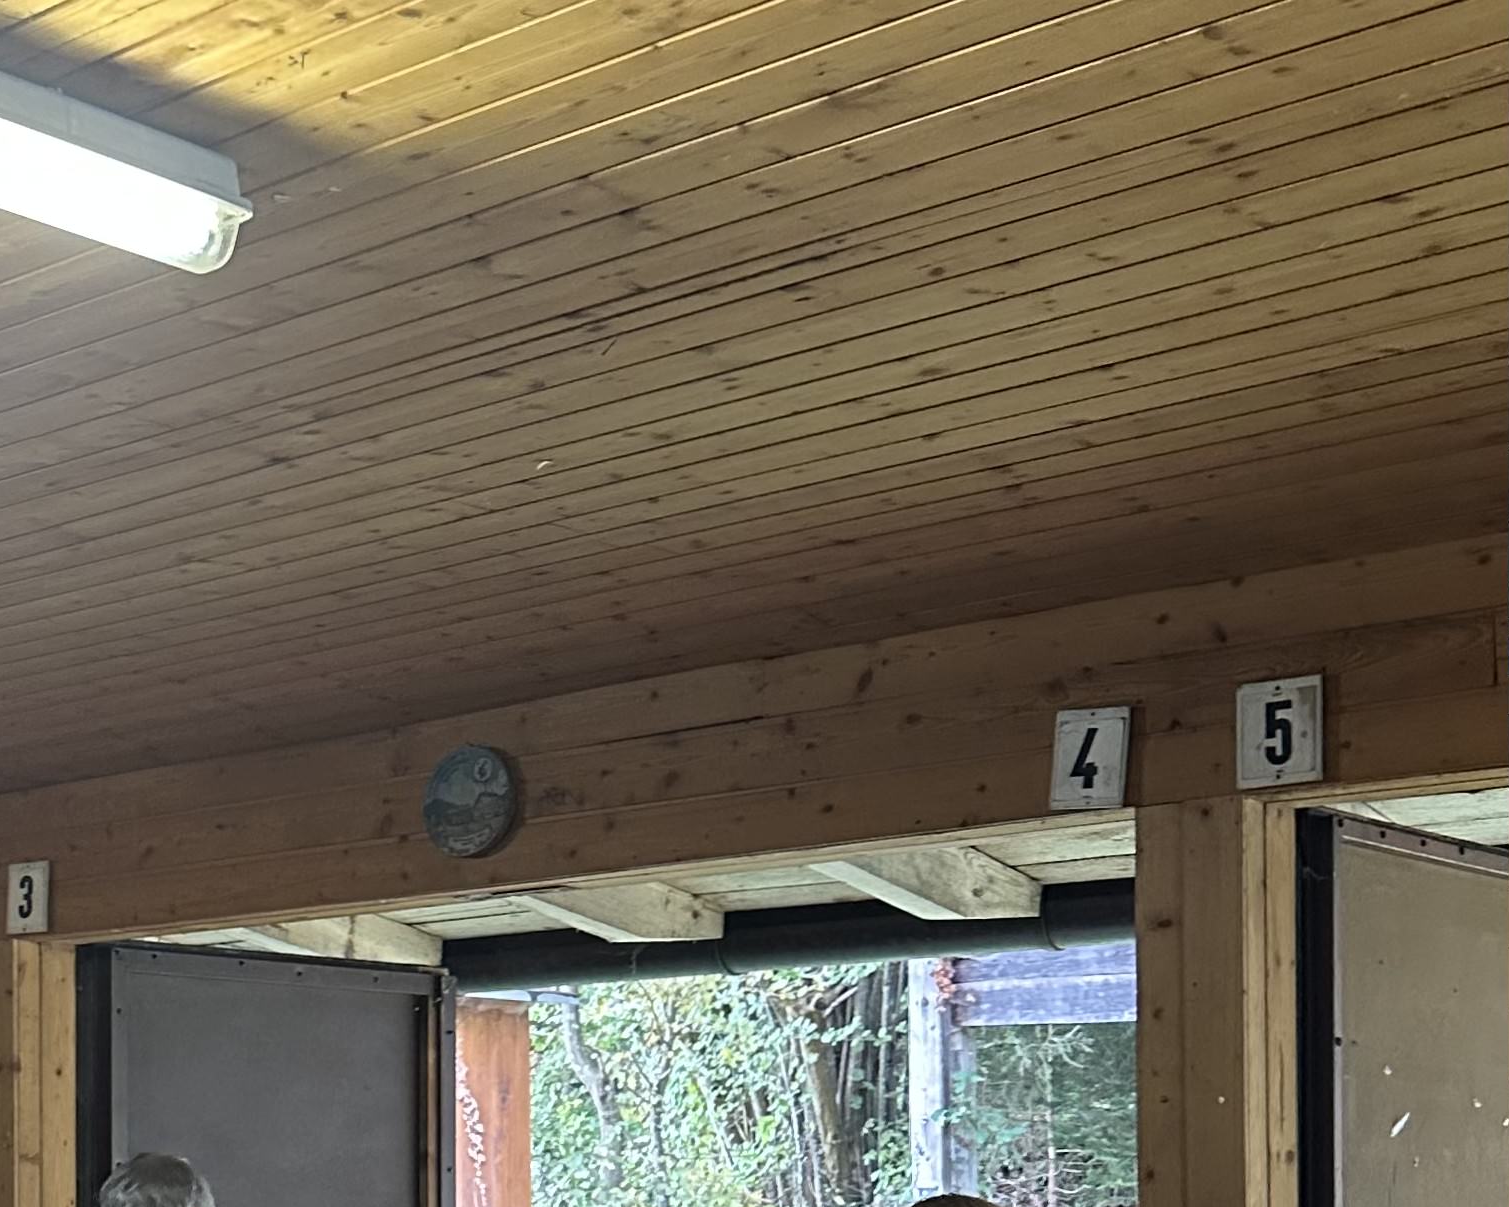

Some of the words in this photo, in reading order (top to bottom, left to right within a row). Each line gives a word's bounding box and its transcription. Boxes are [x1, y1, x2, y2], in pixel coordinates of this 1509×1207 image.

[1069, 727, 1099, 789] 4
[1264, 699, 1293, 765] 5
[18, 875, 34, 918] 3
